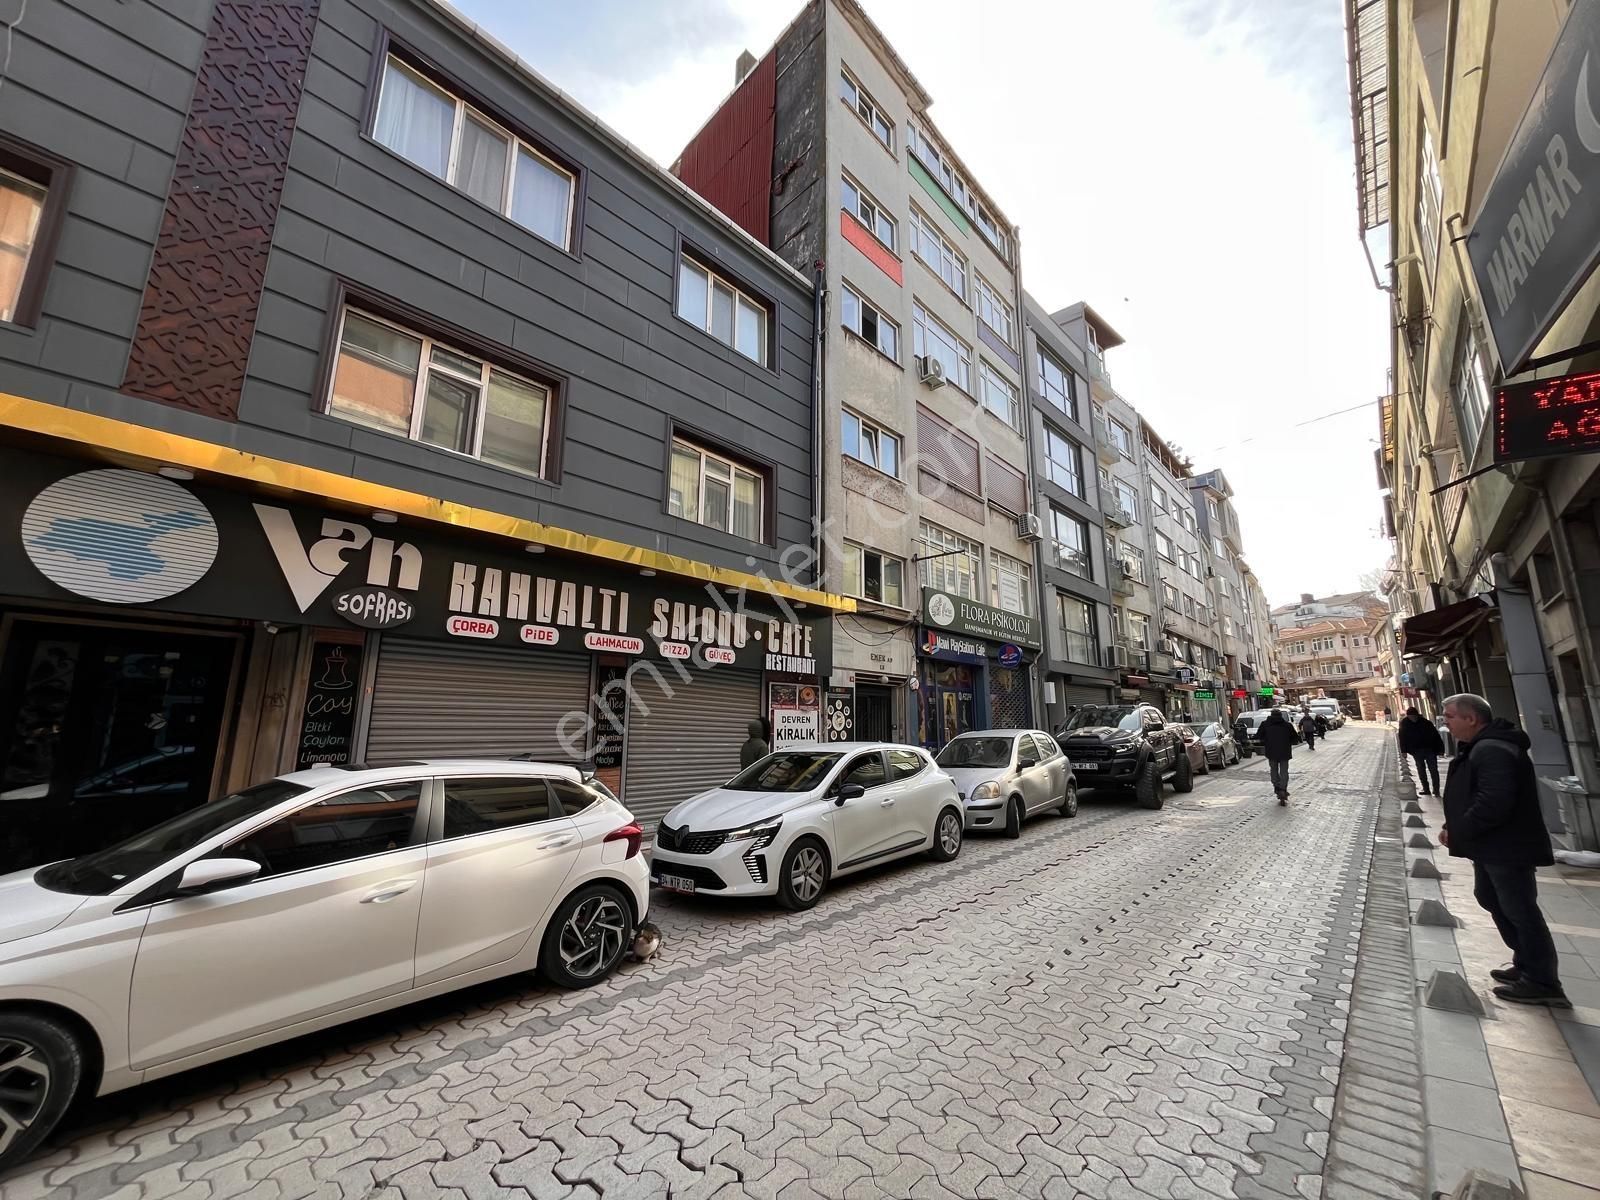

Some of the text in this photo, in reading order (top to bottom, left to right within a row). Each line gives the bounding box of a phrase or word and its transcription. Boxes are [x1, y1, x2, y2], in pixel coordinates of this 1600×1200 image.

[251, 502, 423, 614] Van
[337, 592, 412, 624] SOFRASI
[448, 561, 813, 658] KAHVALTI SALONU CAFE
[453, 619, 495, 635] ÇORBA
[960, 602, 1030, 635] FLORA PSİKOLOJİ
[589, 636, 640, 651] LAHMACUN
[950, 638, 976, 655] PlayStation
[708, 649, 732, 663] GÜVEÇ
[765, 653, 817, 675] RESTAURANT
[307, 694, 353, 717] Çay
[304, 721, 332, 733] Bitki
[781, 716, 811, 724] DEVREN
[776, 725, 816, 741] KİRALIK
